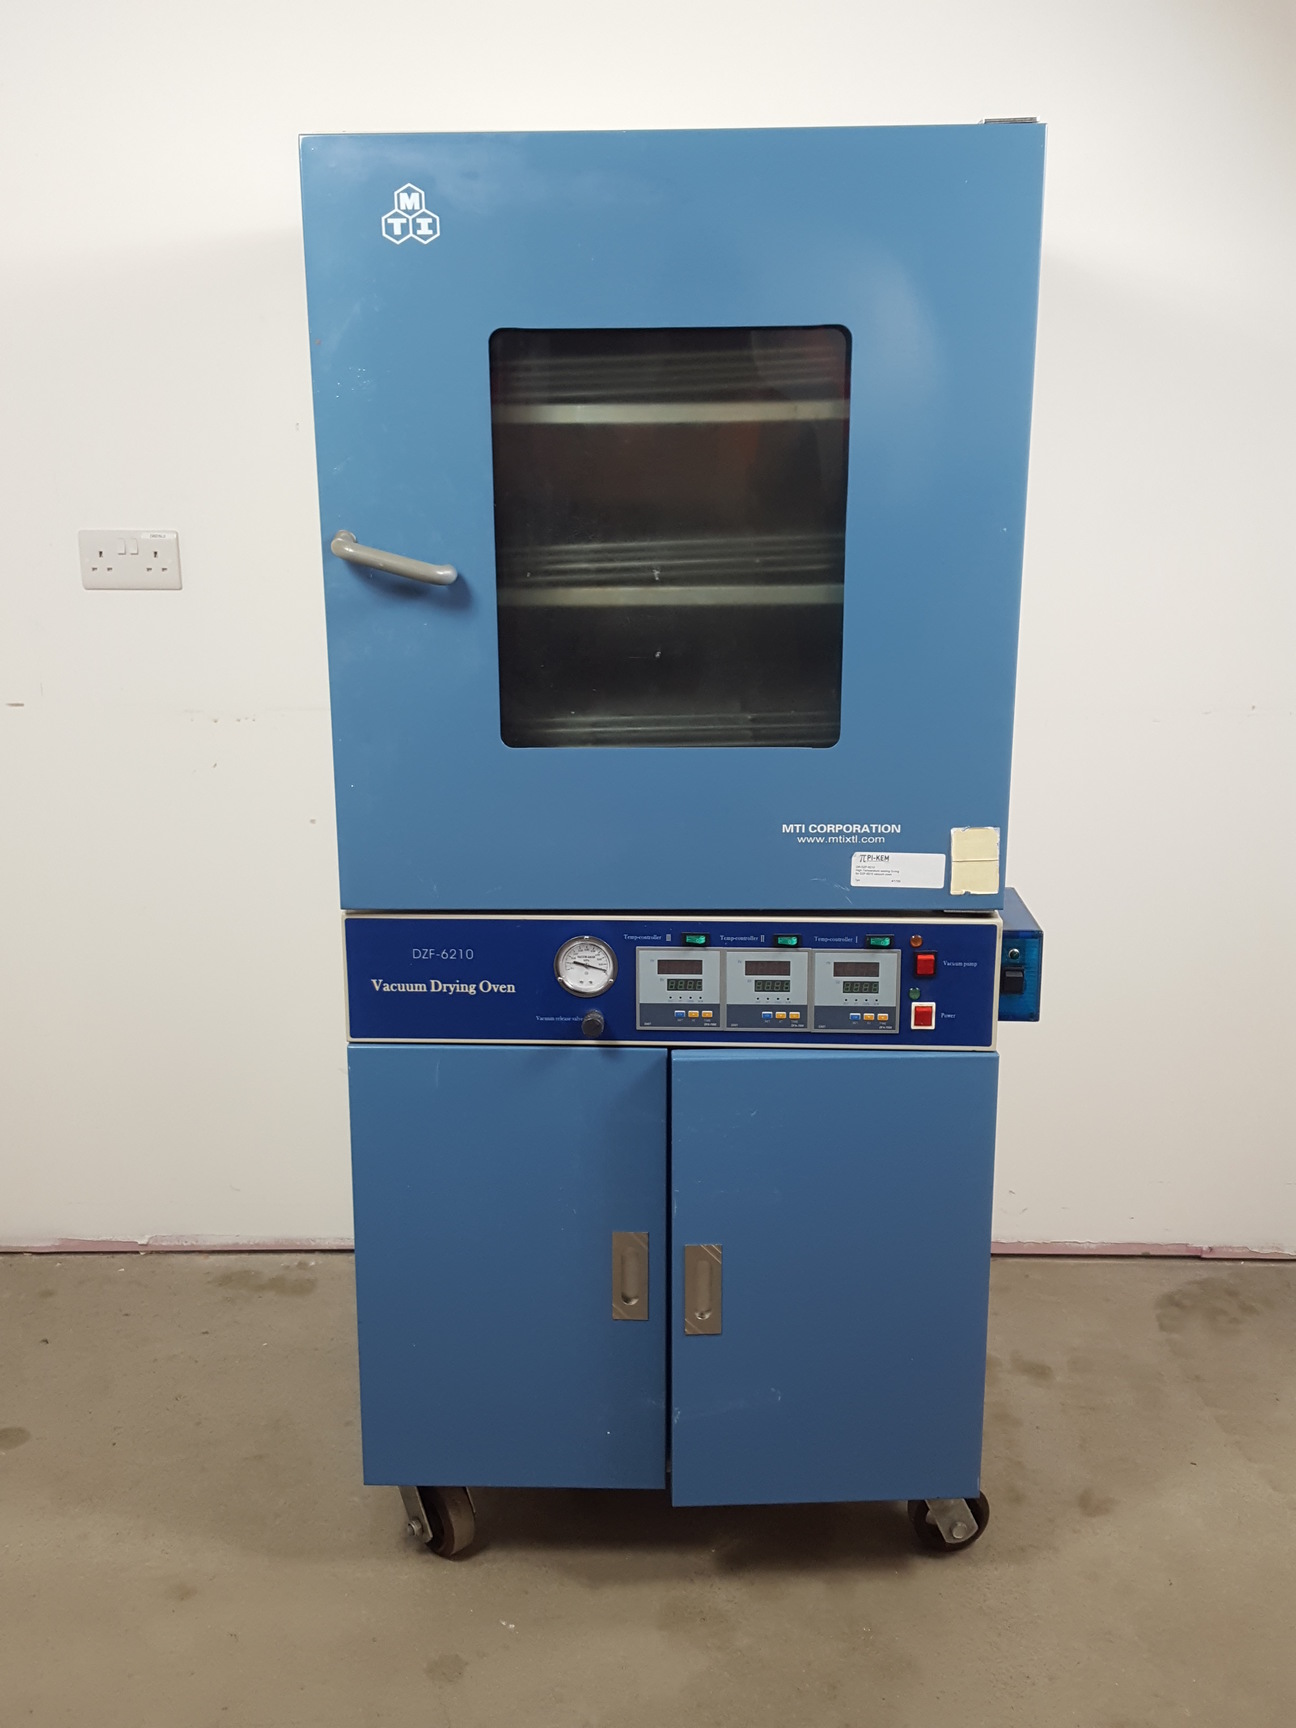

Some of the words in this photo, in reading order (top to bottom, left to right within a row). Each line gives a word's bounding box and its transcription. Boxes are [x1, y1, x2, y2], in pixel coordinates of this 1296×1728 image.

[782, 823, 805, 833] MTI
[808, 823, 901, 833] CORPORATION
[796, 834, 885, 843] www.mtixtl.com
[866, 854, 890, 862] PI-KEM
[412, 948, 474, 960] DZF-6210
[371, 978, 428, 993] Vacuum
[429, 979, 477, 996] Drying
[479, 980, 516, 993] Oven
